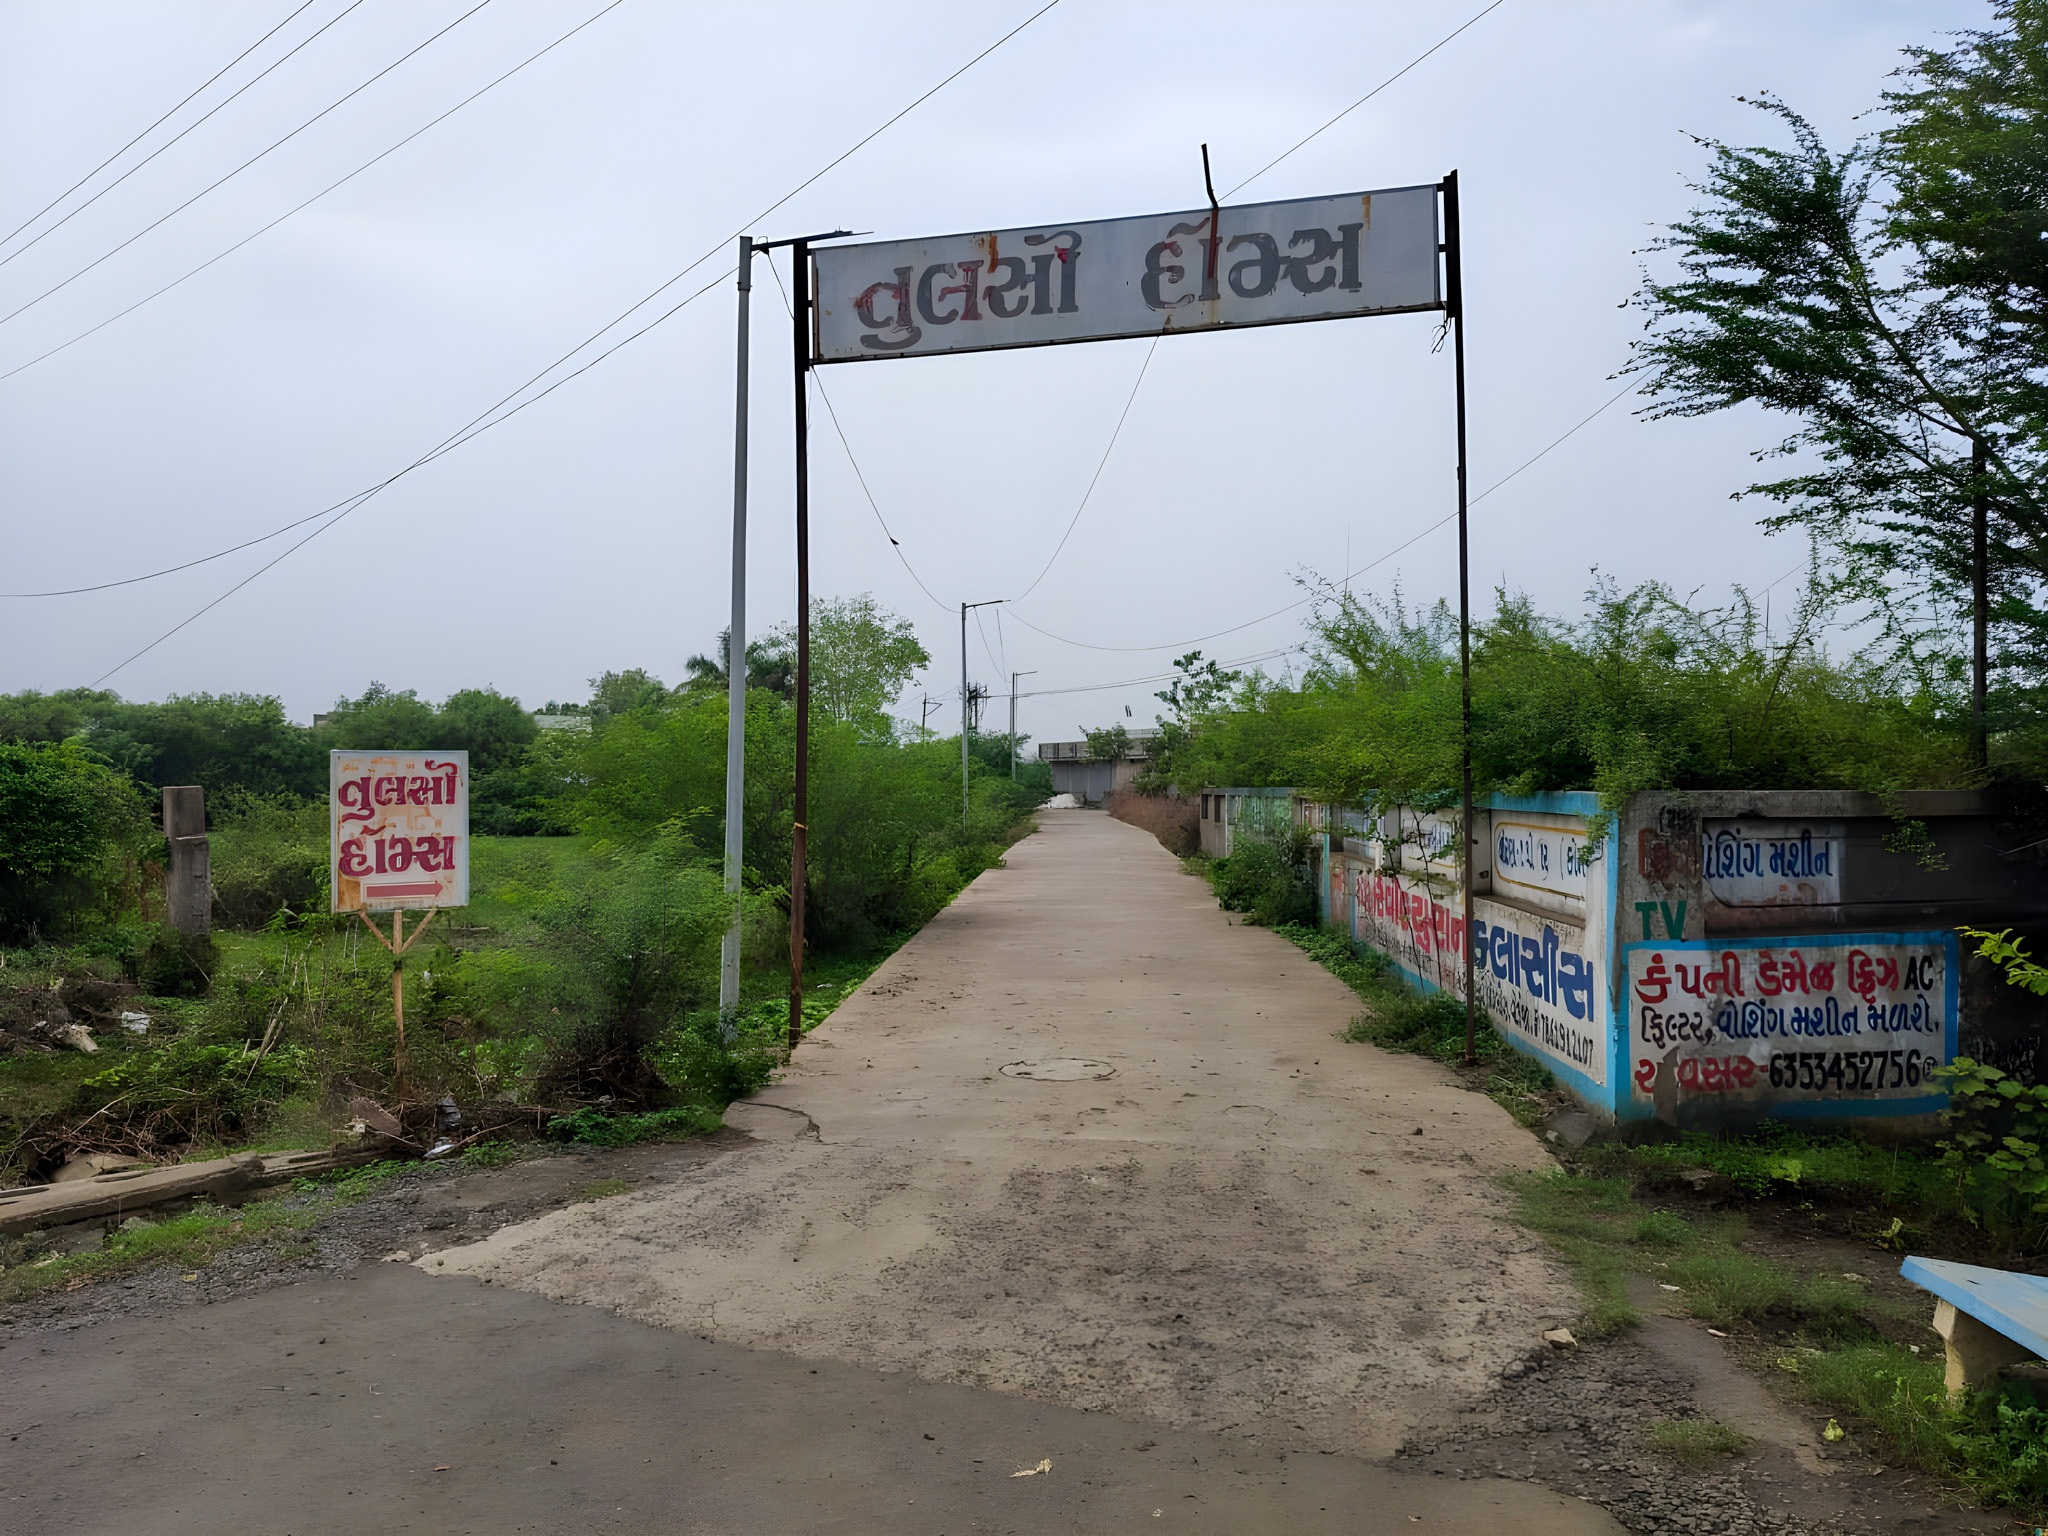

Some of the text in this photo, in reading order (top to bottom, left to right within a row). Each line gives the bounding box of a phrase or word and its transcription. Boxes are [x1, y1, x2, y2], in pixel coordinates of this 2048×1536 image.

[855, 230, 1082, 350] તુલસી
[339, 758, 458, 823] તુલસી
[1769, 828, 1834, 877] મશીન
[1635, 900, 1687, 941] TV
[1635, 951, 1745, 1004] કંપની
[1904, 955, 1934, 991] AC
[1790, 996, 1862, 1037] મશીન
[1769, 1049, 1921, 1092] 6353452756
